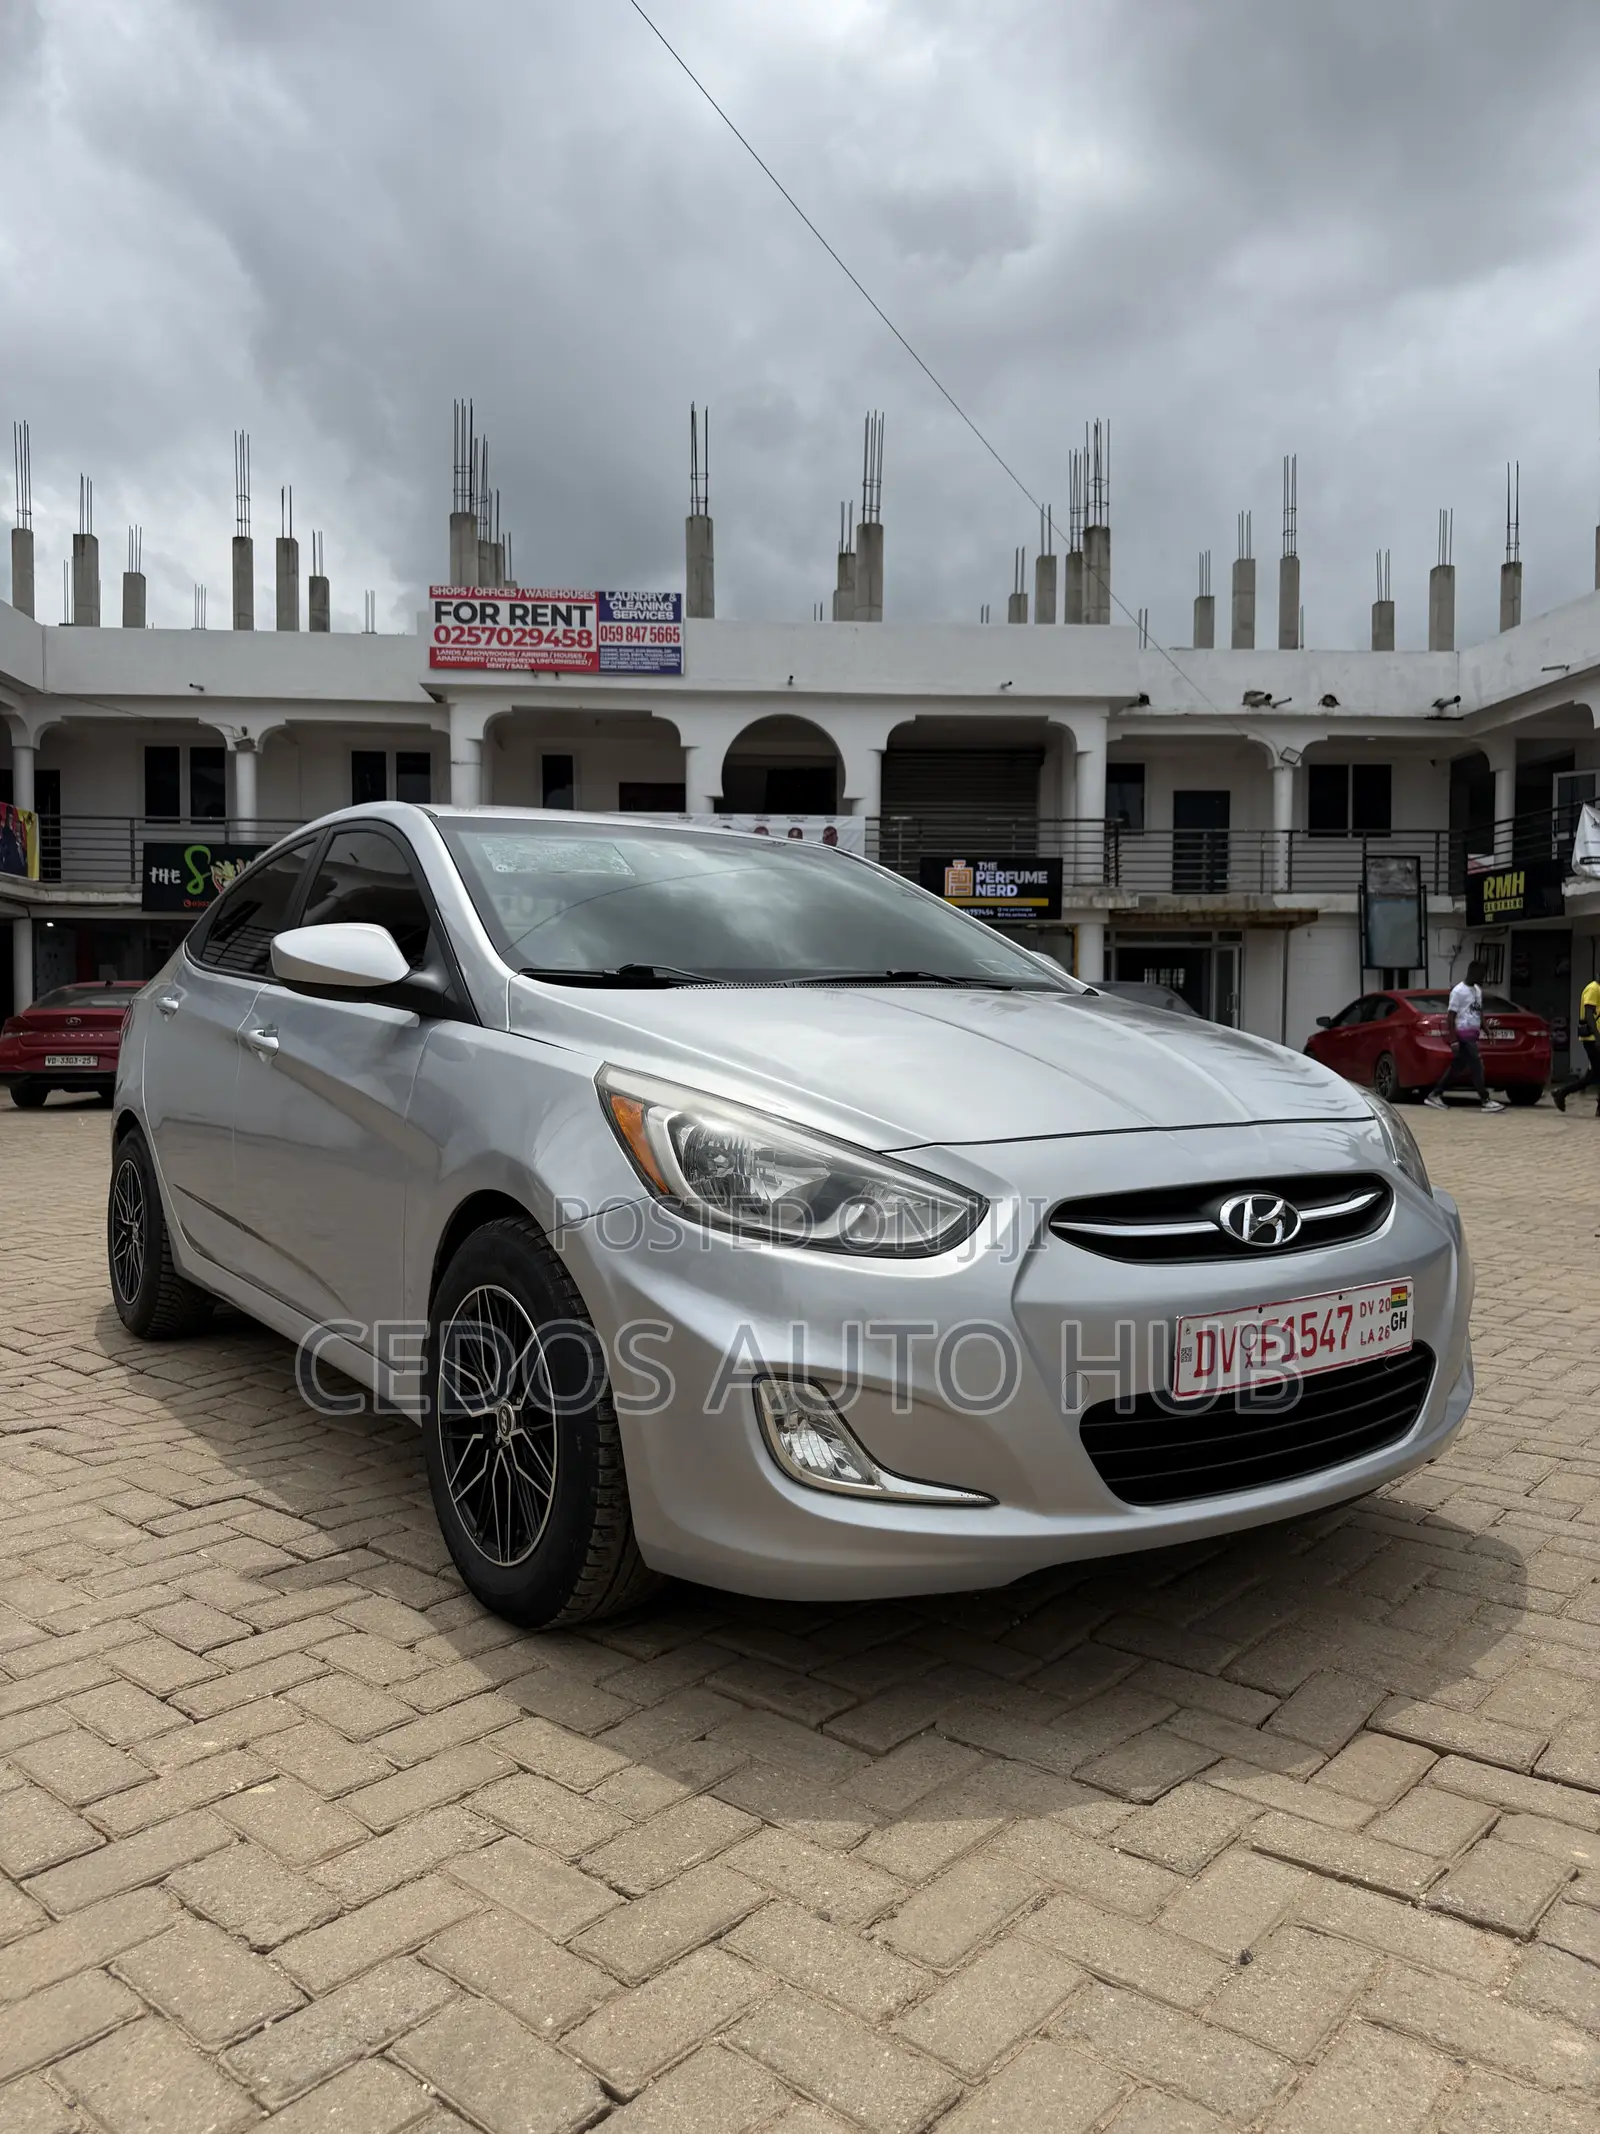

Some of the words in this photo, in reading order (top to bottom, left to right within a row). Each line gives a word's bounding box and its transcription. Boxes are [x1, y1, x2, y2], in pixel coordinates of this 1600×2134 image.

[432, 587, 467, 596] SHOPS
[475, 588, 517, 598] OFFICES
[525, 589, 596, 600] WAREHOUSES
[605, 591, 665, 602] LAUNDRY
[668, 593, 677, 602] &
[434, 601, 500, 625] FOR
[509, 603, 593, 628] RENT
[609, 601, 673, 611] CLEANING
[612, 610, 674, 620] SERVICES
[433, 625, 593, 649] 0257029458
[600, 625, 624, 642] 059
[625, 626, 648, 643] 847
[649, 626, 680, 644] 5665
[977, 861, 998, 871] THE
[975, 870, 1048, 884] PERFUME
[1483, 871, 1525, 900] RMH
[975, 884, 1018, 897] NERD
[1359, 1302, 1374, 1318] DV
[1378, 1298, 1391, 1312] 20
[1390, 1310, 1408, 1332] GH
[1360, 1330, 1375, 1345] LA
[1378, 1325, 1391, 1340] 26
[1193, 1325, 1238, 1378] DV
